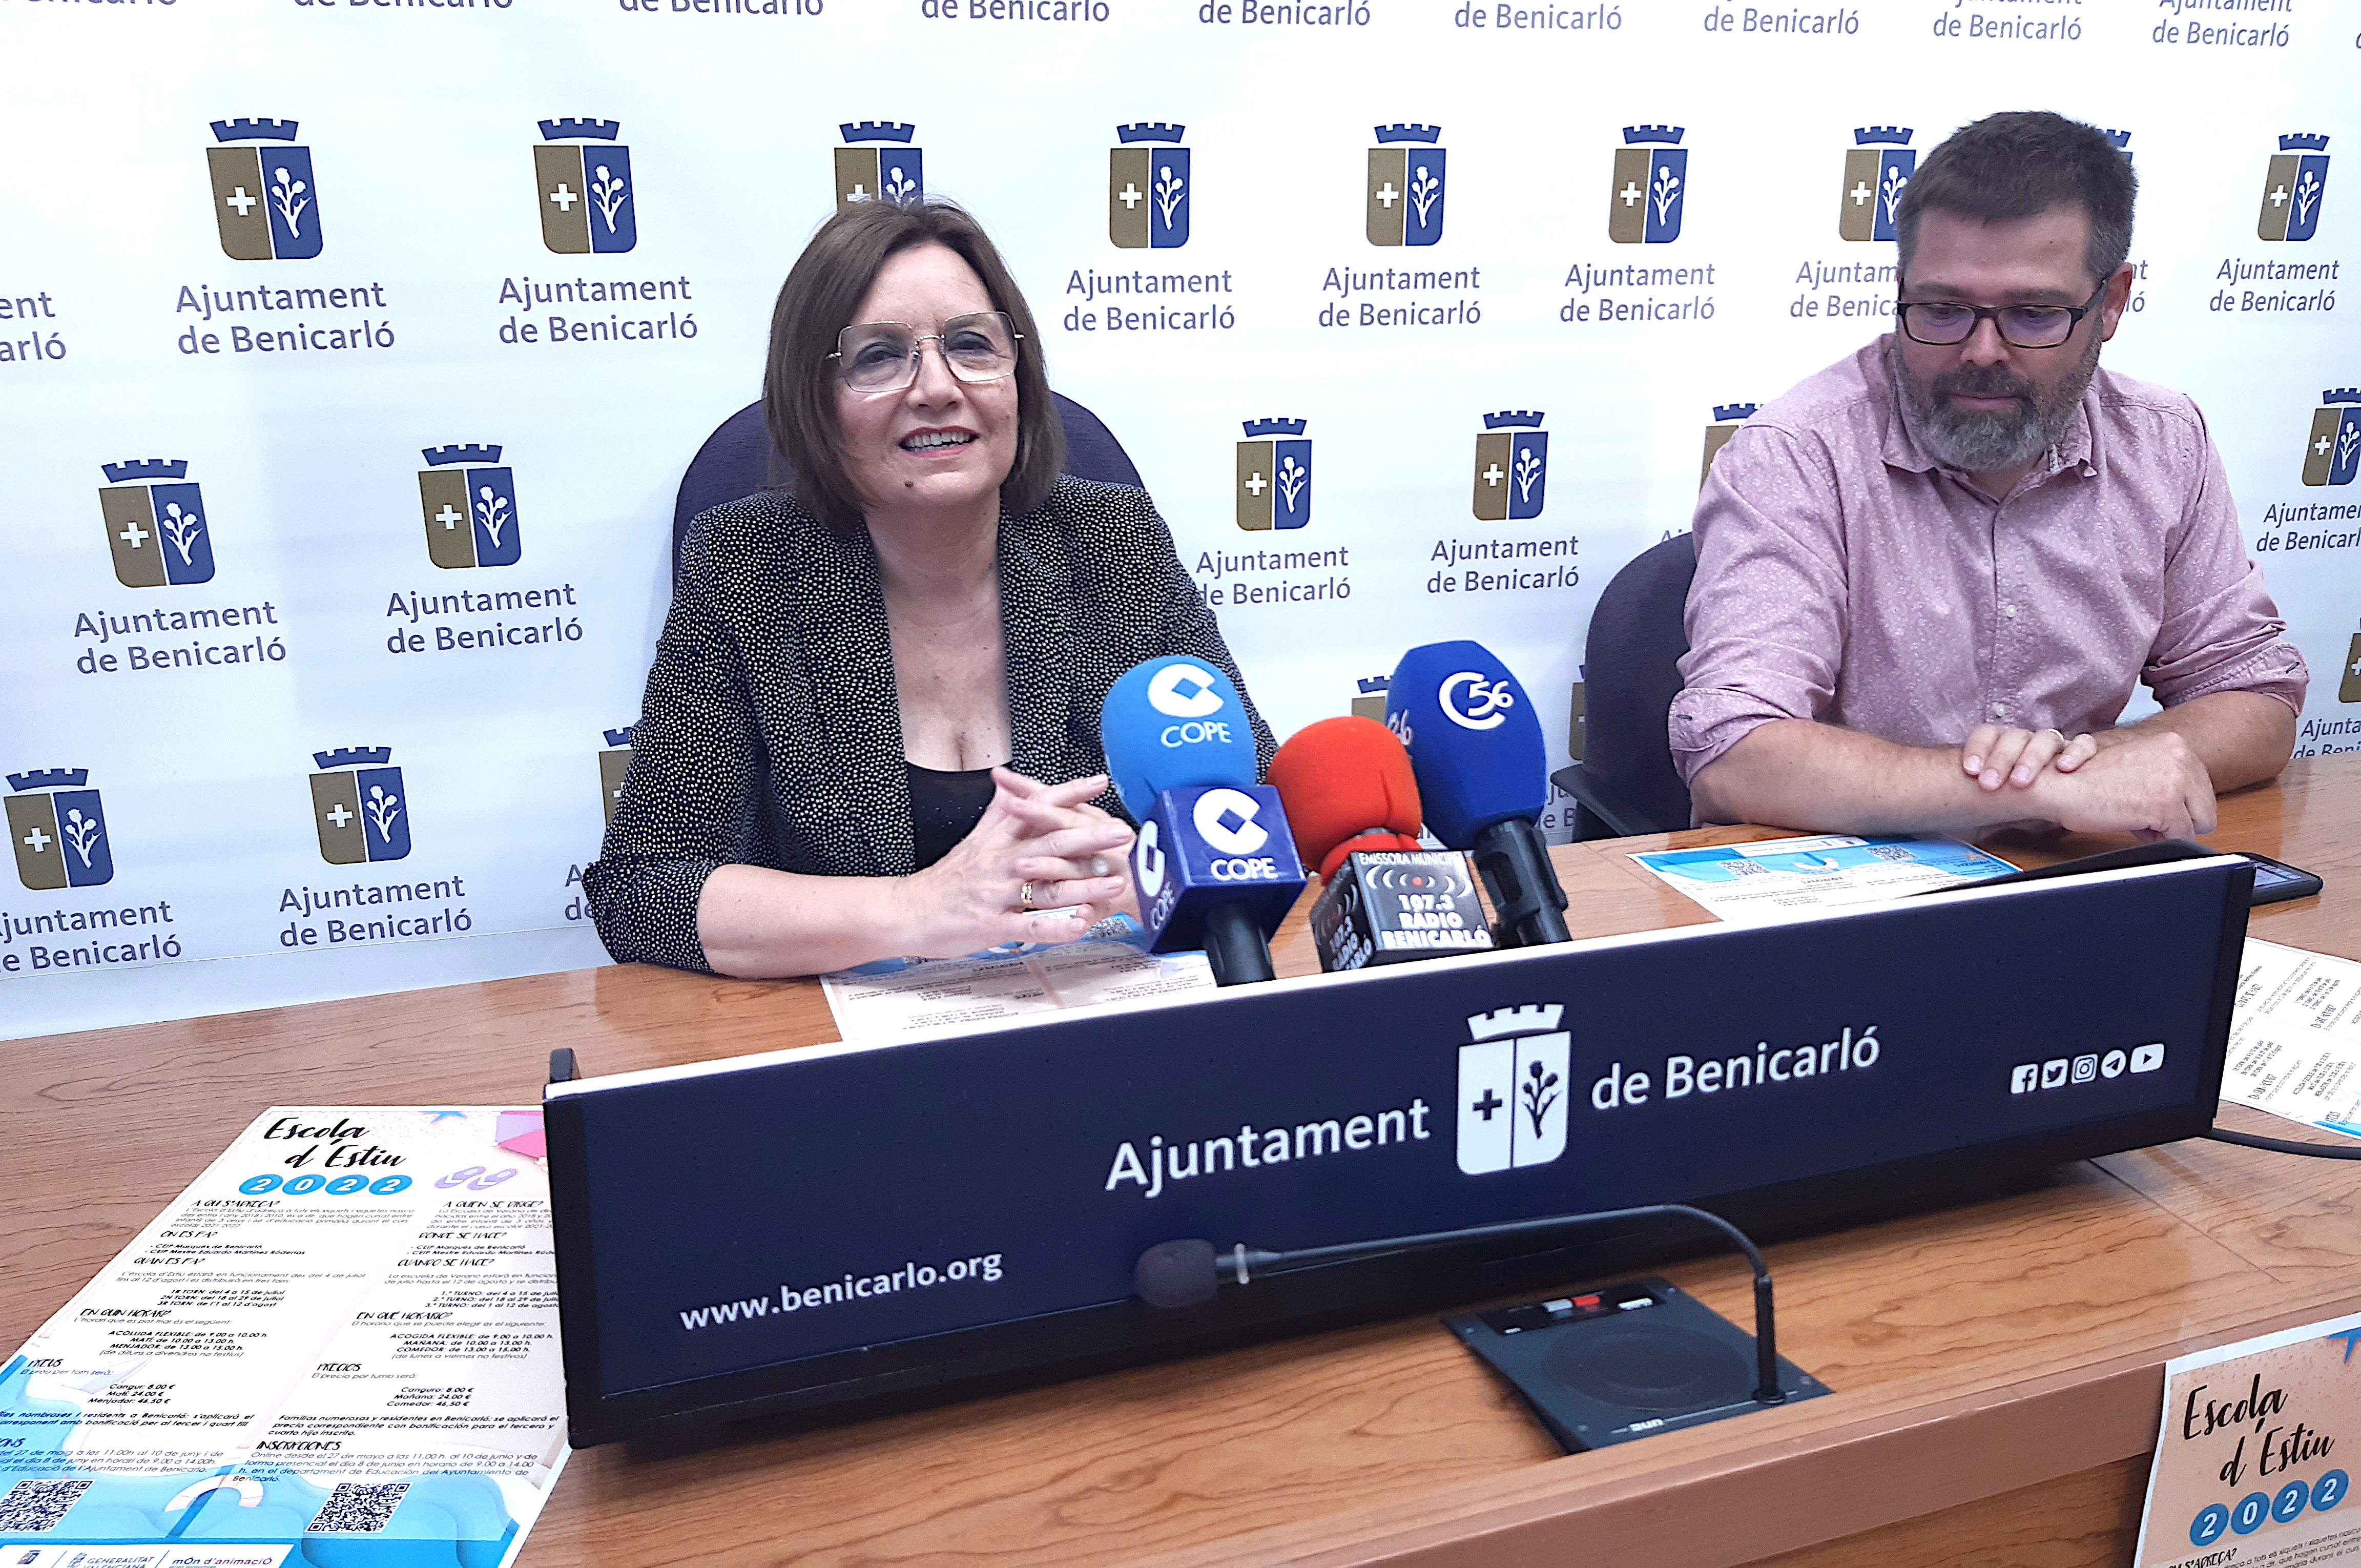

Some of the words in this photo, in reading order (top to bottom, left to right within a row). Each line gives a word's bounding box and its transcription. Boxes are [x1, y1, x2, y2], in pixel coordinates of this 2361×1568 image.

[922, 0, 958, 18] de
[1199, 0, 1232, 24] de
[1242, 0, 1370, 26] Benicarló
[1455, 1, 1486, 27] de
[1497, 4, 1621, 30] Benicarló
[1705, 6, 1734, 31] de
[1744, 8, 1858, 34] Benicarló
[1934, 12, 1961, 36] de
[1970, 14, 2081, 40] Benicarló
[2153, 19, 2179, 43] de
[2187, 22, 2289, 47] Benicarló
[1066, 269, 1232, 301] Ajuntament
[1323, 267, 1480, 298] Ajuntament
[1565, 263, 1715, 294] Ajuntament
[1796, 260, 1897, 290] Ajuntam
[2217, 258, 2339, 286] Ajuntament
[176, 282, 386, 319] Ajuntament
[499, 276, 692, 311] Ajuntament
[1790, 294, 1818, 317] de
[1827, 294, 1897, 316] Benic
[2210, 290, 2234, 311] de
[2241, 290, 2335, 311] Benicarló
[1064, 306, 1096, 331] de
[1107, 304, 1234, 330] Benicarló
[1319, 302, 1350, 327] de
[1360, 300, 1480, 326] Benicarló
[1560, 298, 1589, 322] de
[1599, 296, 1714, 321] Benicarló
[178, 325, 220, 354] de
[231, 320, 394, 352] Benicarló
[500, 316, 537, 343] de
[549, 312, 697, 342] Benicarló
[2264, 503, 2361, 528] Ajuntame
[1431, 536, 1578, 564] Ajuntament
[2256, 532, 2280, 551] de
[2285, 527, 2361, 550] Benicarl
[1196, 547, 1348, 579] Ajuntament
[1234, 577, 1350, 604] Benicarló
[1427, 570, 1456, 593] de
[1465, 566, 1579, 591] Benicarló
[387, 584, 577, 618] Ajuntament
[74, 602, 277, 643] Ajuntament
[388, 626, 425, 653] de
[436, 617, 583, 650] Benicarló
[77, 648, 117, 674] de
[129, 637, 285, 670] Benicarló
[1161, 721, 1232, 748] COPE
[2301, 718, 2361, 741] Ajunta
[1210, 858, 1278, 881] COPE
[1359, 853, 1409, 865] EMISSORA
[280, 875, 465, 918] Ajuntament
[1151, 881, 1175, 931] COPE
[1398, 894, 1455, 911] 107.3
[0, 901, 173, 943] juntament
[280, 923, 317, 950] de
[328, 909, 472, 943] Benicarló
[1381, 924, 1494, 948] BENICARLÓ
[3, 955, 20, 971] e
[30, 933, 181, 969] Benicarló
[1105, 1099, 1430, 1198] Ajuntament
[1592, 1063, 1650, 1109] de
[1666, 1026, 1879, 1099] Benicarló
[264, 1117, 370, 1140] Escola
[247, 1177, 404, 1192] 2022
[680, 1254, 1002, 1329] www.benicarlo.org
[27, 1359, 64, 1368] PREUS
[317, 1363, 362, 1371] PRECIOS
[2184, 1373, 2288, 1440] Escola
[256, 1441, 342, 1450] INSCRIPCIONES
[2199, 1476, 2339, 1539] 2022
